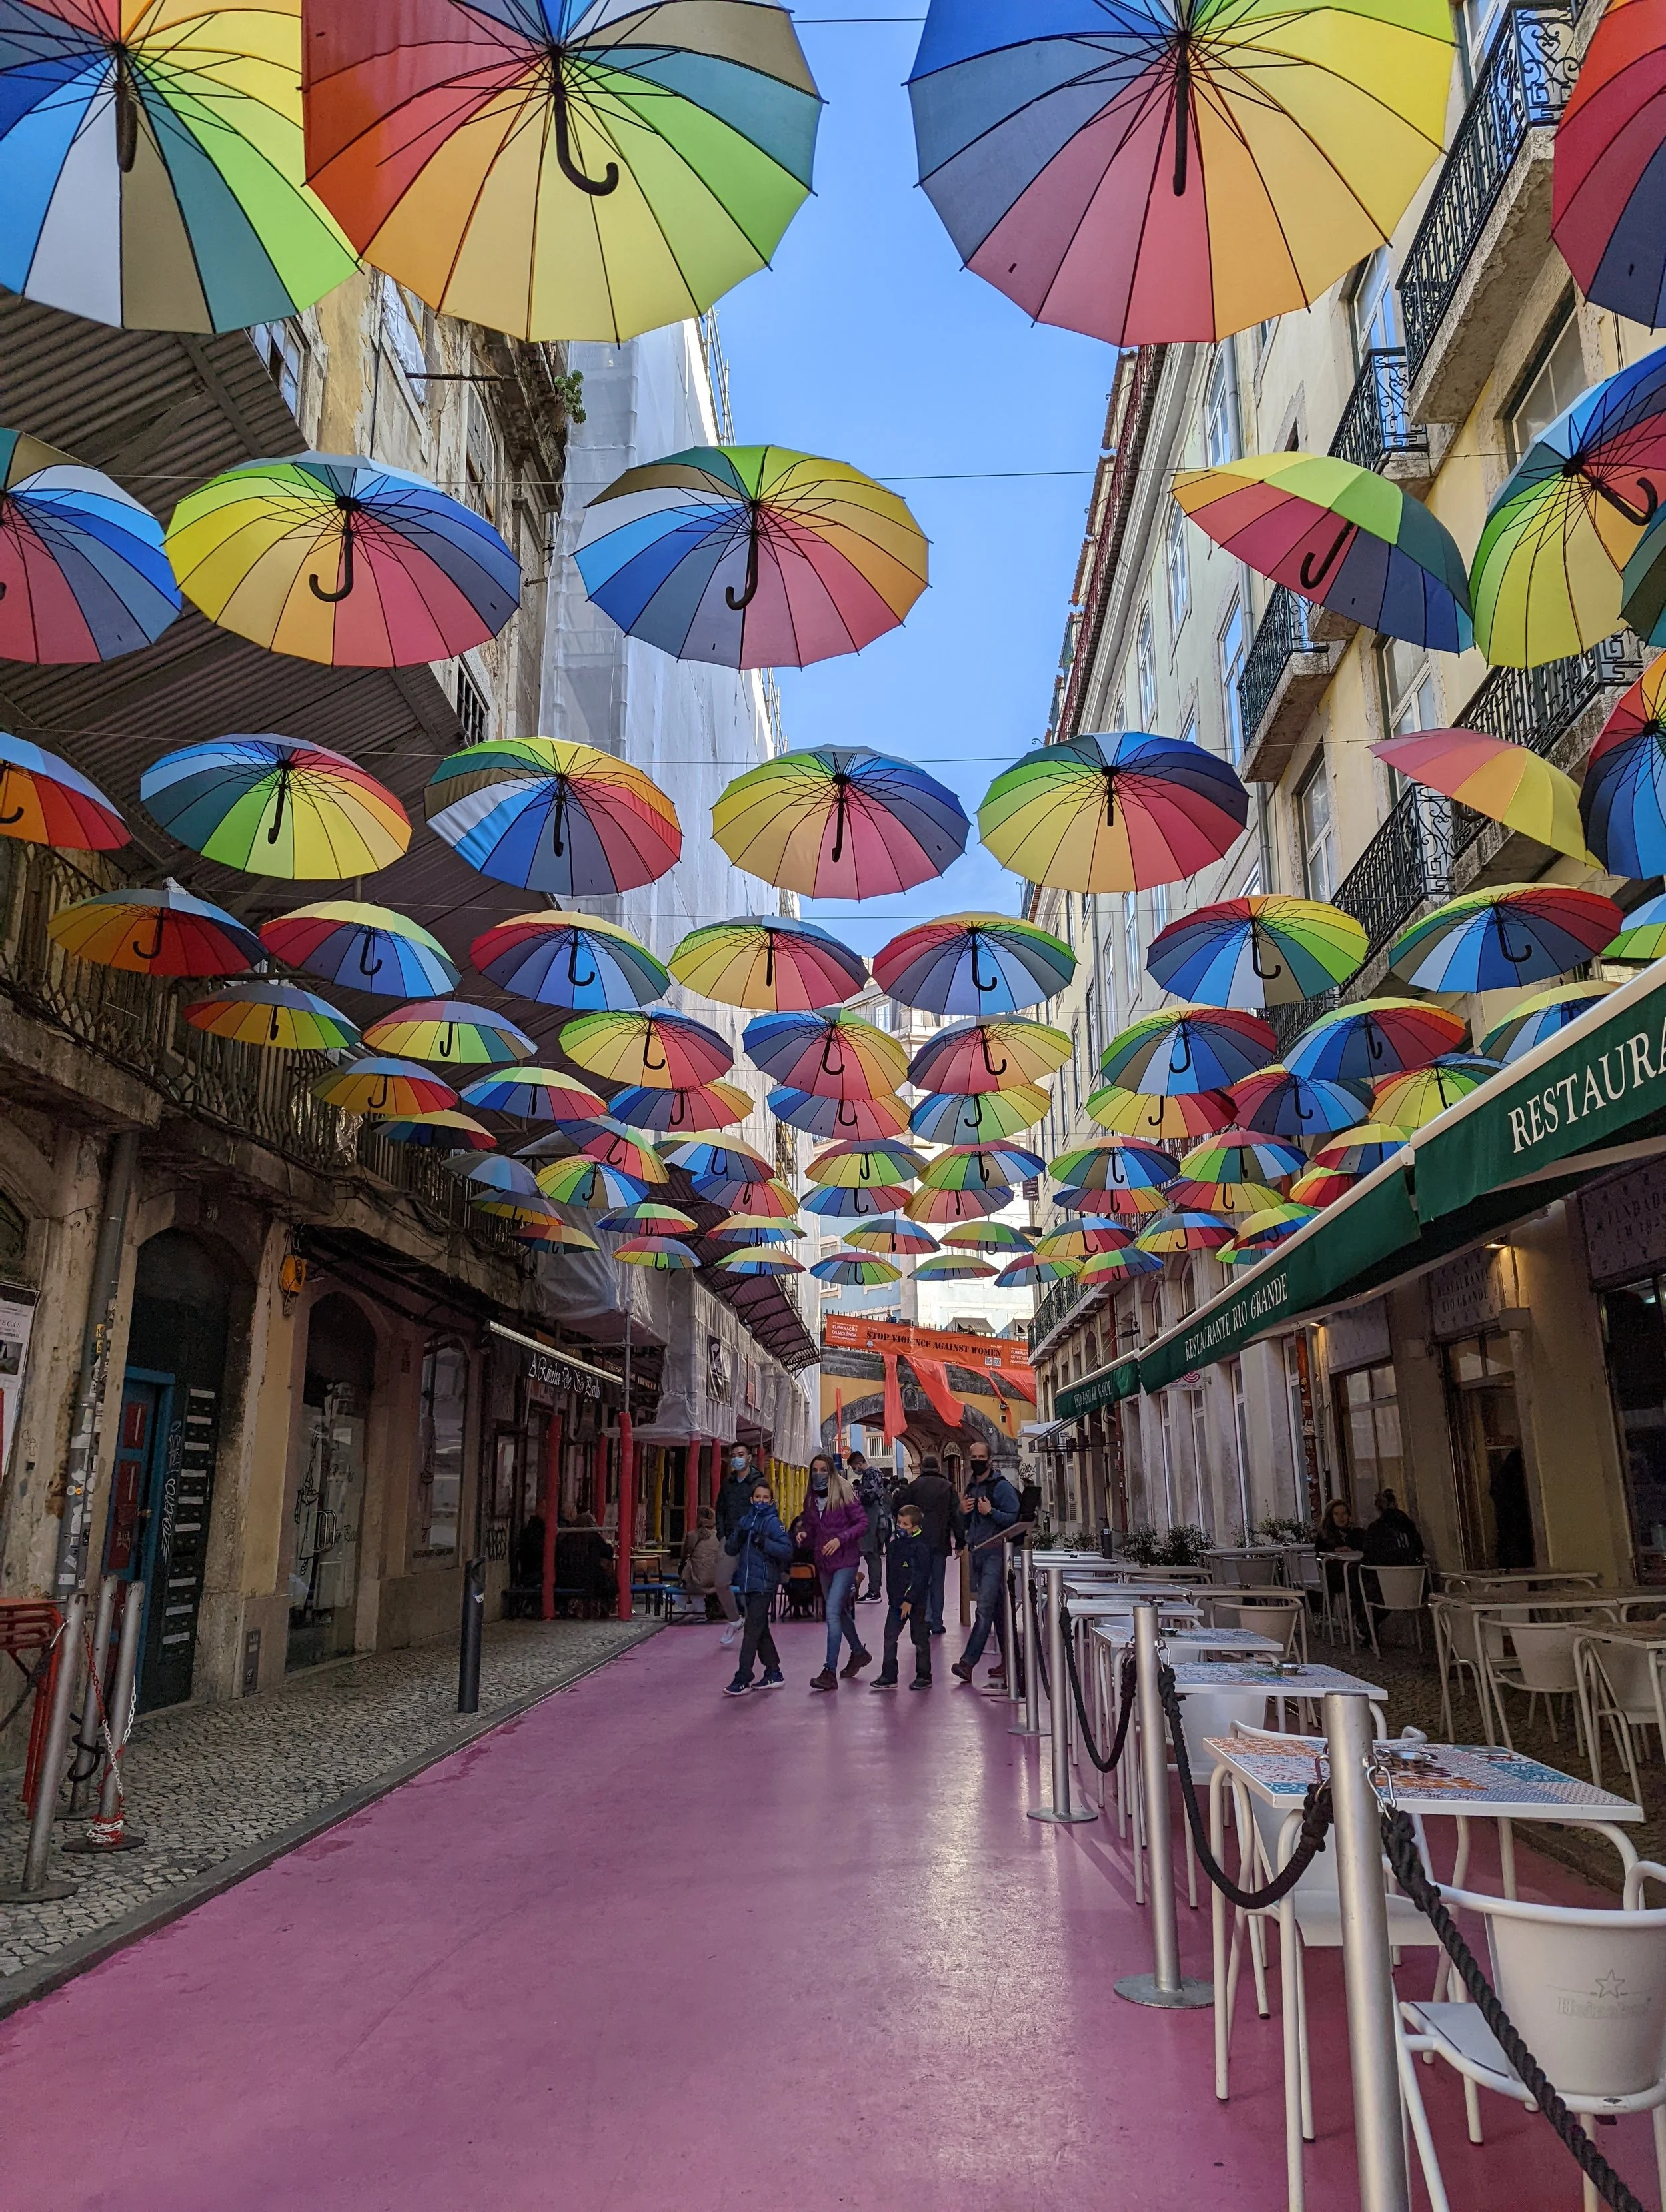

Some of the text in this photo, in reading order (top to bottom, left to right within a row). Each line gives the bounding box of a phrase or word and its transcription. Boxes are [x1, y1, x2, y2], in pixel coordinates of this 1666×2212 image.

[1184, 1273, 1288, 1361] RESTAURANTE RIO GRANDE
[866, 1331, 890, 1341] STOP
[892, 1334, 931, 1347] VIOLENCE
[933, 1341, 969, 1353] AGAINST
[971, 1346, 1002, 1357] WOMEN
[528, 1353, 537, 1378] A
